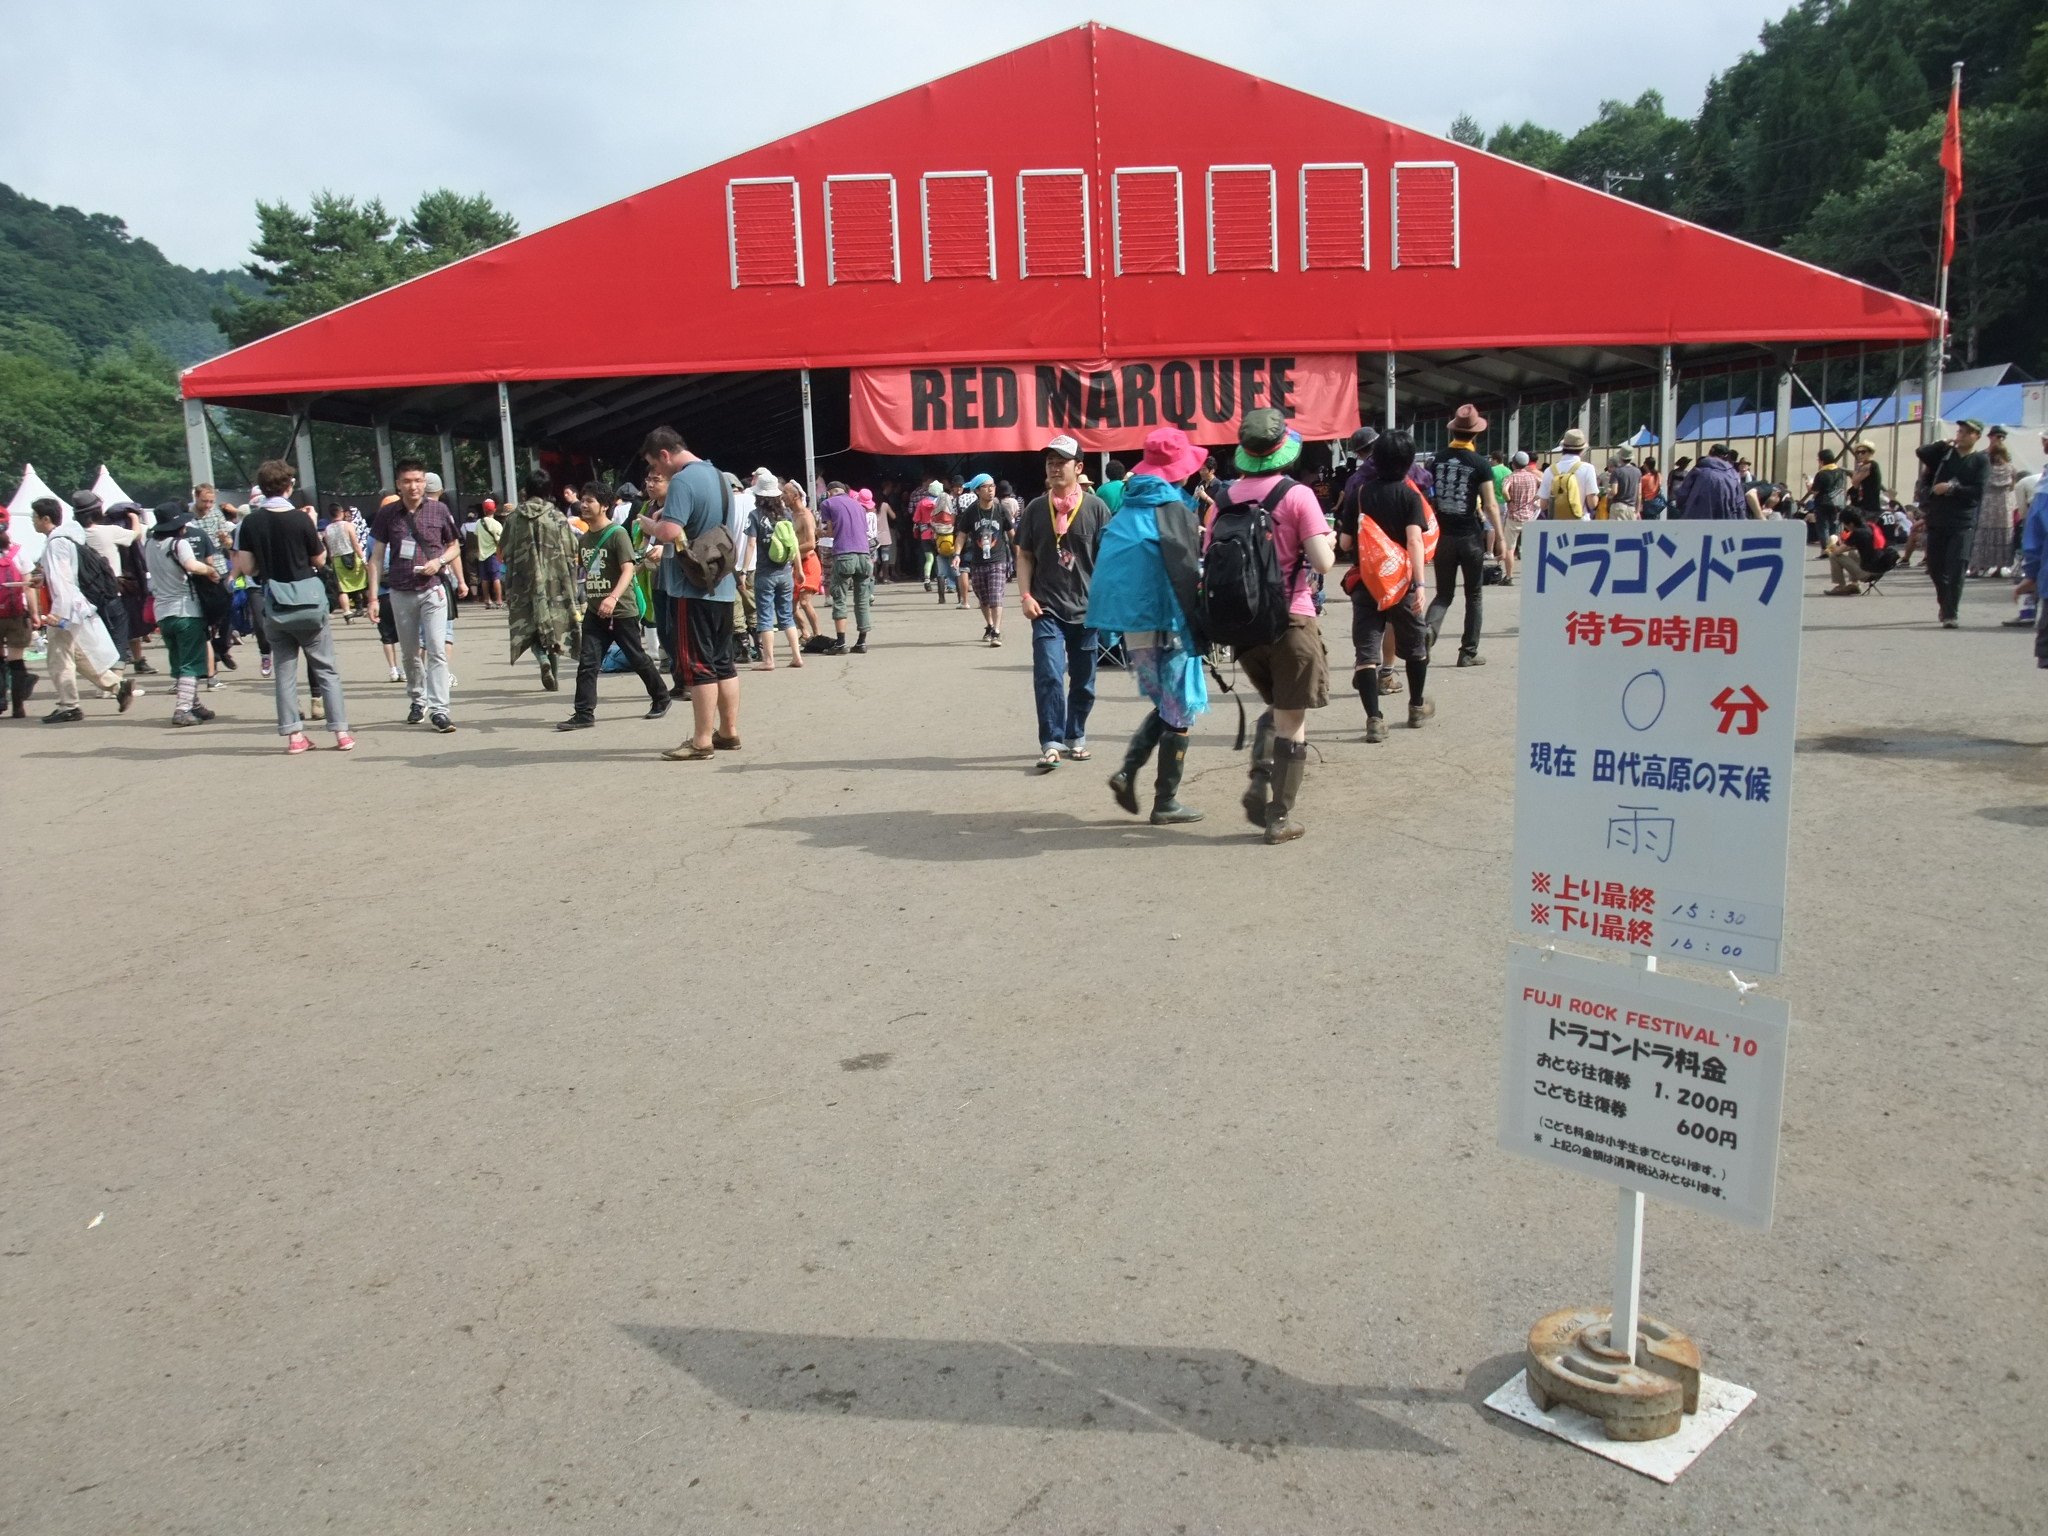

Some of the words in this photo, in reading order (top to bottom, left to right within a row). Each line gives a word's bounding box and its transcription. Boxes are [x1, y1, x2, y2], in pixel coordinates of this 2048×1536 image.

[910, 367, 1019, 431] RED
[1035, 357, 1296, 431] MARQUEE
[1536, 531, 1784, 605] ドラゴンドラ
[1565, 611, 1739, 655] 待ち時間
[1710, 684, 1769, 735] 分
[1530, 742, 1577, 778] 現在
[1592, 750, 1772, 803] 田代高原の天候
[1606, 804, 1676, 863] 雨
[1522, 987, 1562, 1009] FUJI
[1568, 1000, 1617, 1022] ROCK
[1625, 1011, 1720, 1047] FESTIVAL
[1536, 1052, 1631, 1090] おとな往復券
[1548, 1018, 1727, 1084] ドラゴンドラ料金
[1533, 1079, 1628, 1118] こども往復券
[1676, 1119, 1738, 1150] 600円
